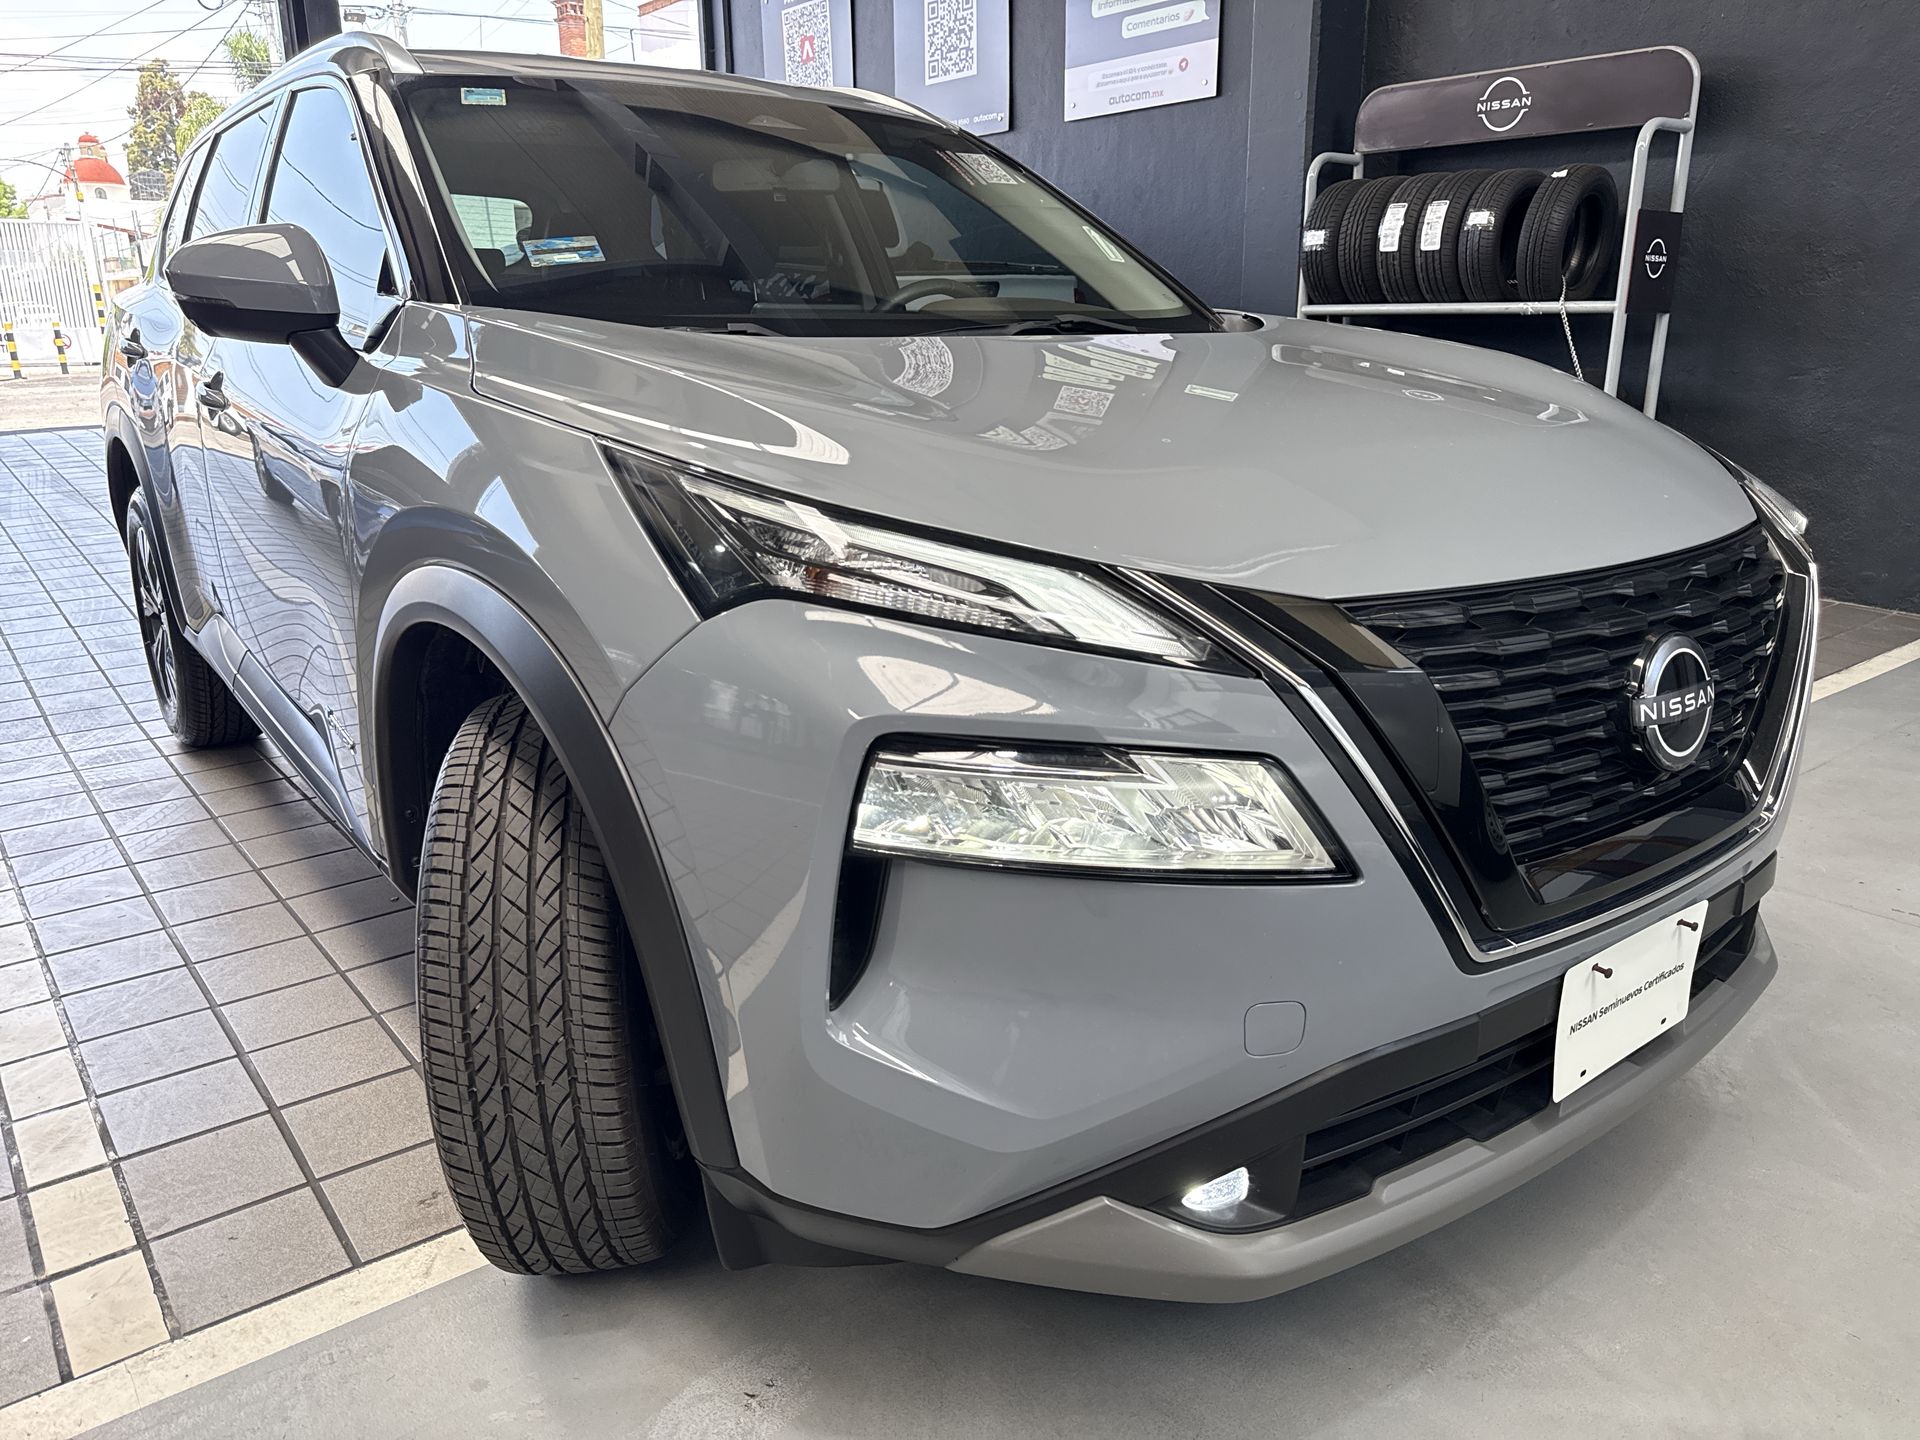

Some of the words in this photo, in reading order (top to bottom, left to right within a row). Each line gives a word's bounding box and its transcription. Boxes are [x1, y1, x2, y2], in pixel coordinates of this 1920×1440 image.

[1126, 12, 1180, 31] Comentarios
[1108, 89, 1164, 105] autocom.mx
[1476, 96, 1532, 113] NISSAN
[1645, 254, 1667, 263] NISSAN
[1640, 682, 1714, 722] NISSAN
[1569, 1010, 1598, 1035] NISSAN
[1598, 986, 1643, 1018] Seminuevos
[1643, 962, 1685, 991] Certificados
